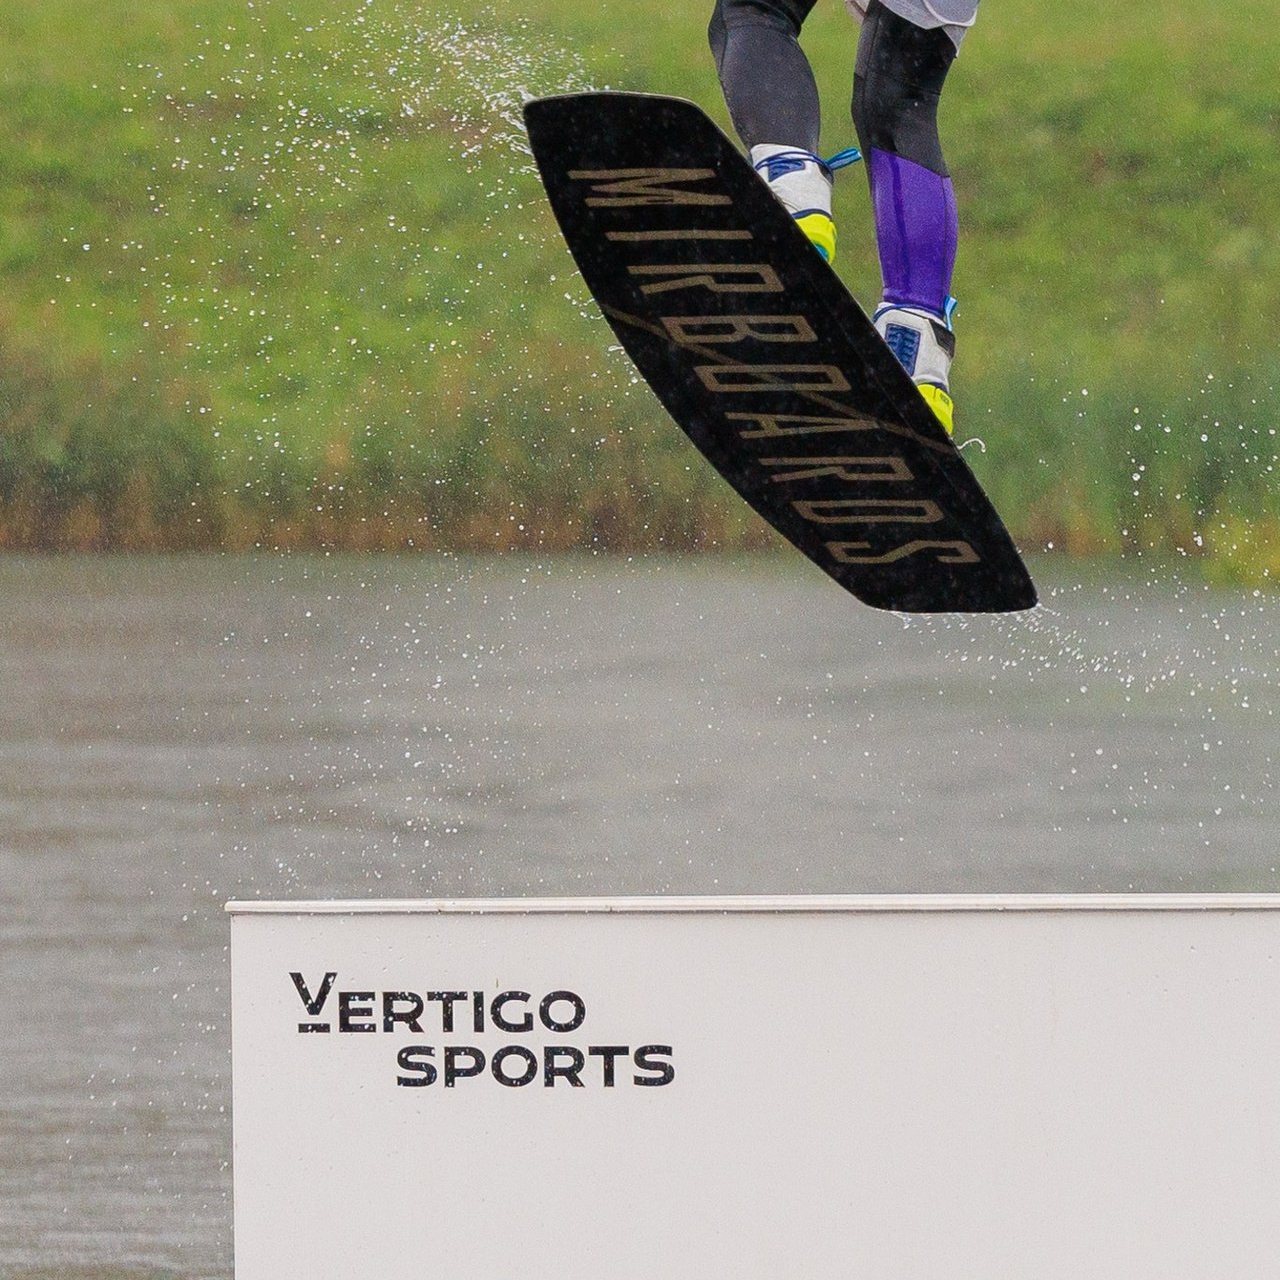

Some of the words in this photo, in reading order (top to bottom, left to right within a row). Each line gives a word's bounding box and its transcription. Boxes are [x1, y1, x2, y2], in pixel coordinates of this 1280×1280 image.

[567, 167, 982, 565] MIRBOARDS
[289, 972, 586, 1034] VERTIGO
[397, 1044, 675, 1088] SPORTS
